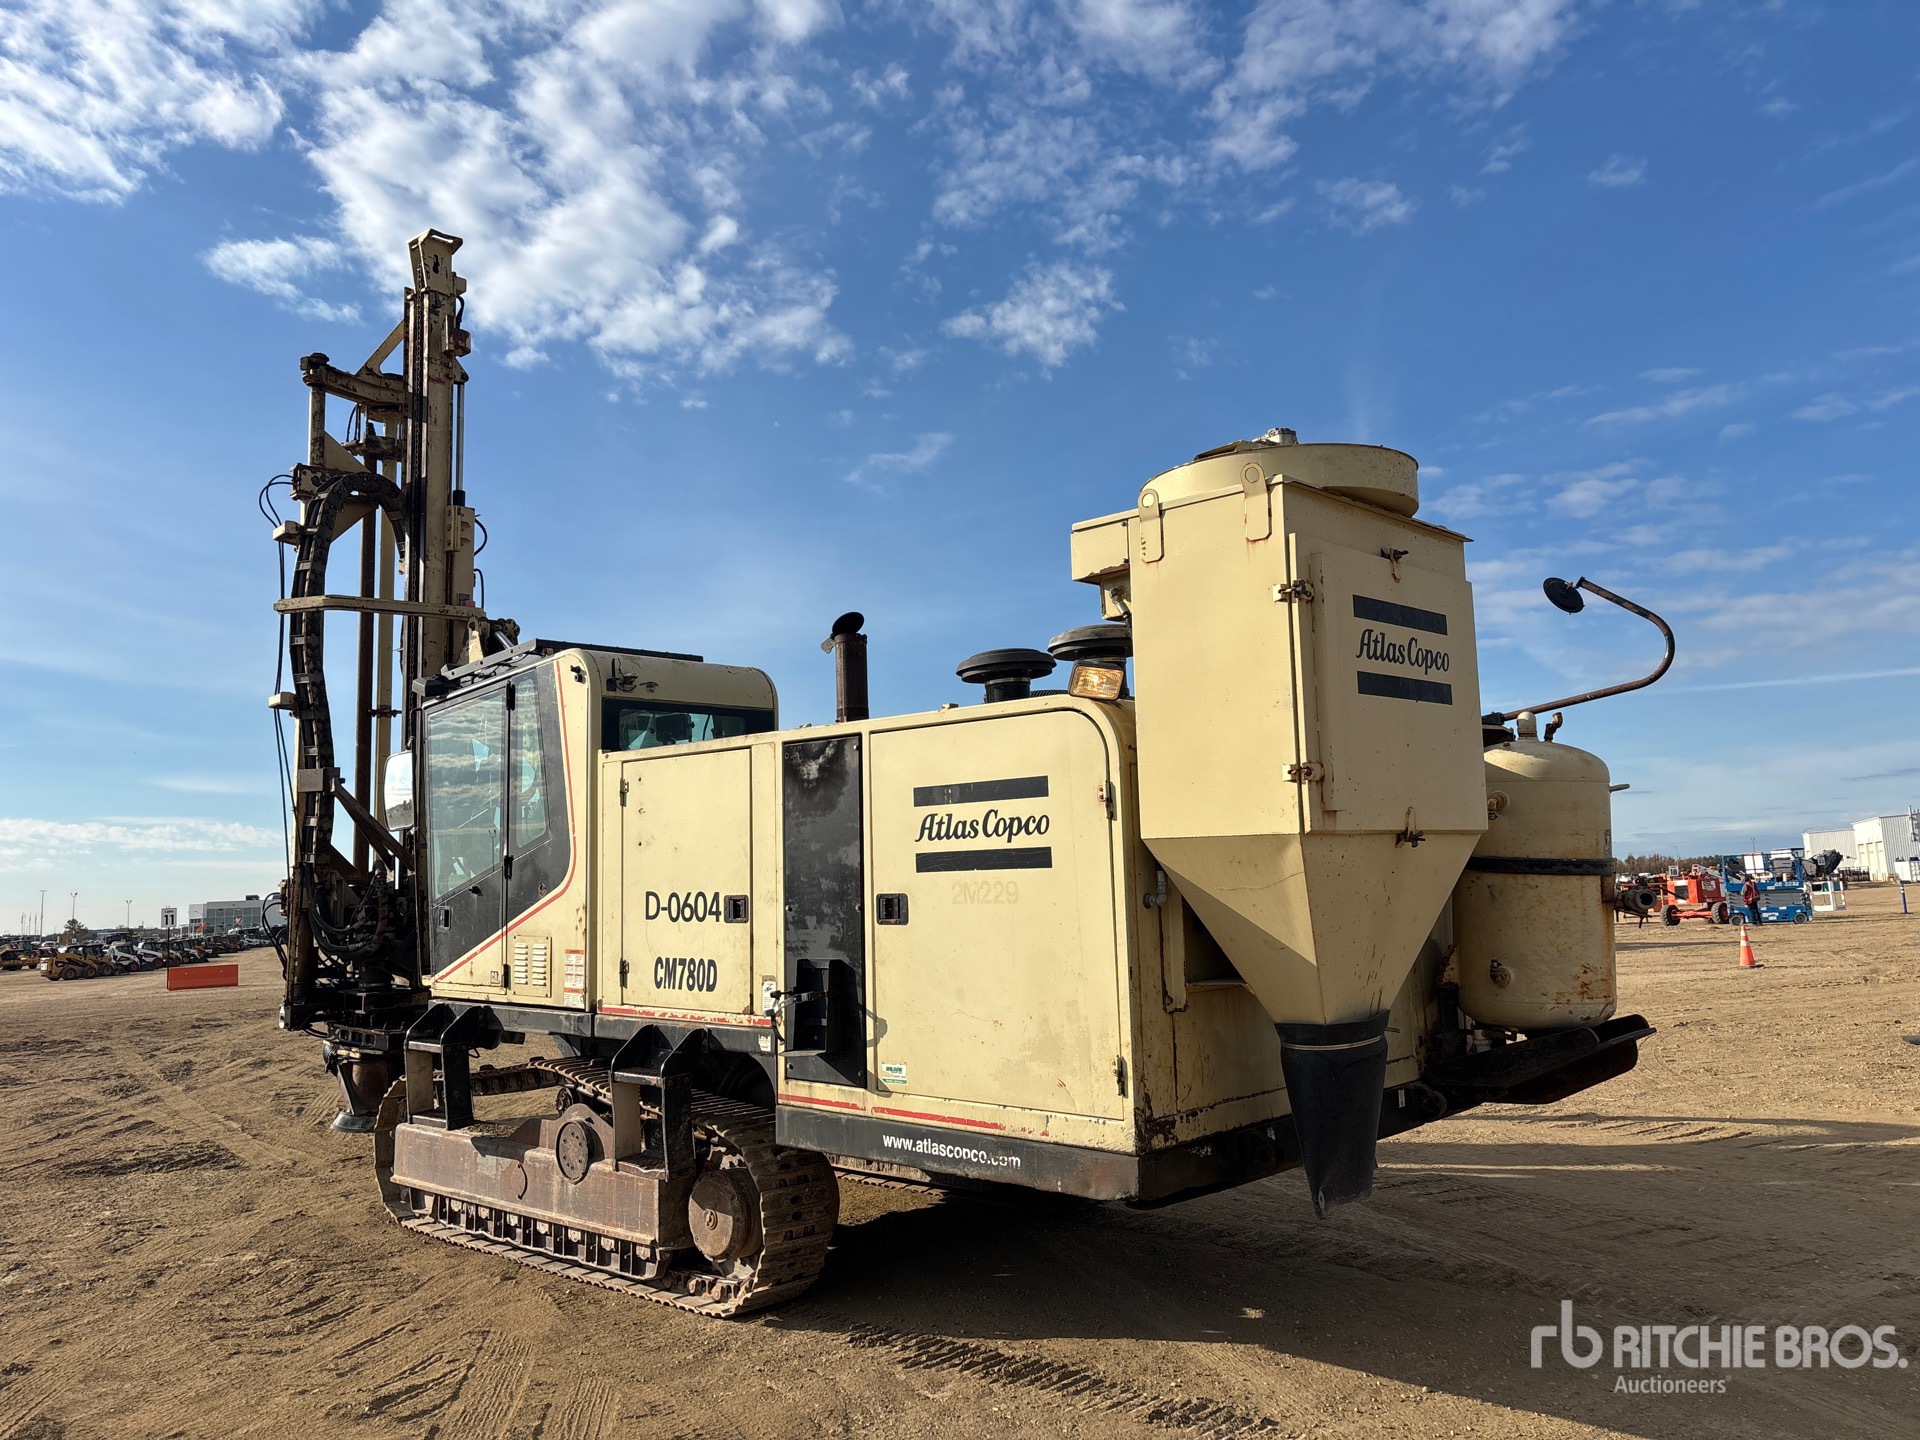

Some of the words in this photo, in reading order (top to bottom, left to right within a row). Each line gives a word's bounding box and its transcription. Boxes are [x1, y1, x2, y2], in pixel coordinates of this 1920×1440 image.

[1355, 628, 1405, 665] Atlas
[1407, 636, 1450, 676] Copco
[914, 812, 980, 842] Atlas
[982, 808, 1050, 844] Copco
[645, 890, 722, 923] D-0604
[951, 880, 1020, 905] 2M229
[164, 914, 174, 925] 11
[653, 956, 718, 993] CM780D
